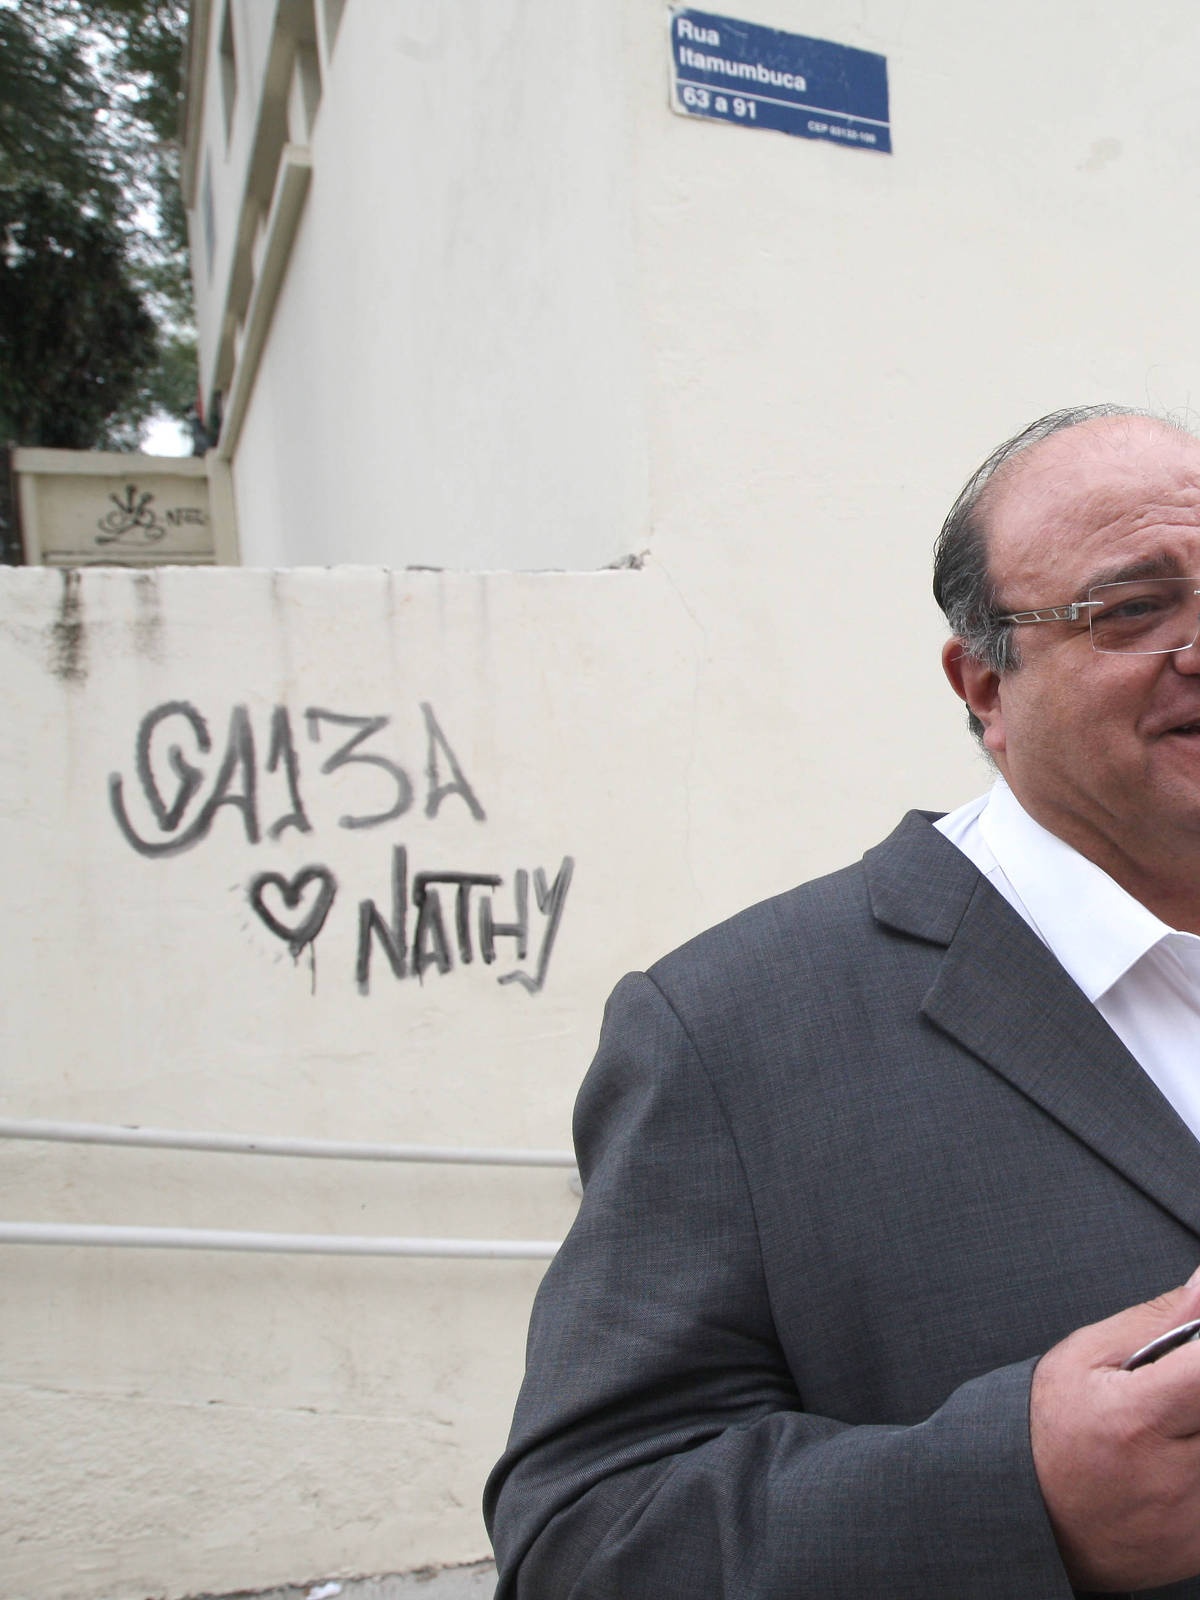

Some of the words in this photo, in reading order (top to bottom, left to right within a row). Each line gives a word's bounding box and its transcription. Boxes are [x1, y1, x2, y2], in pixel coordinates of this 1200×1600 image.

[677, 18, 720, 46] Rua
[679, 46, 807, 92] Itamumbuca
[683, 87, 710, 109] 63
[715, 96, 728, 113] a
[733, 97, 757, 119] 91
[807, 120, 829, 133] CEP
[355, 843, 575, 996] NATHY
